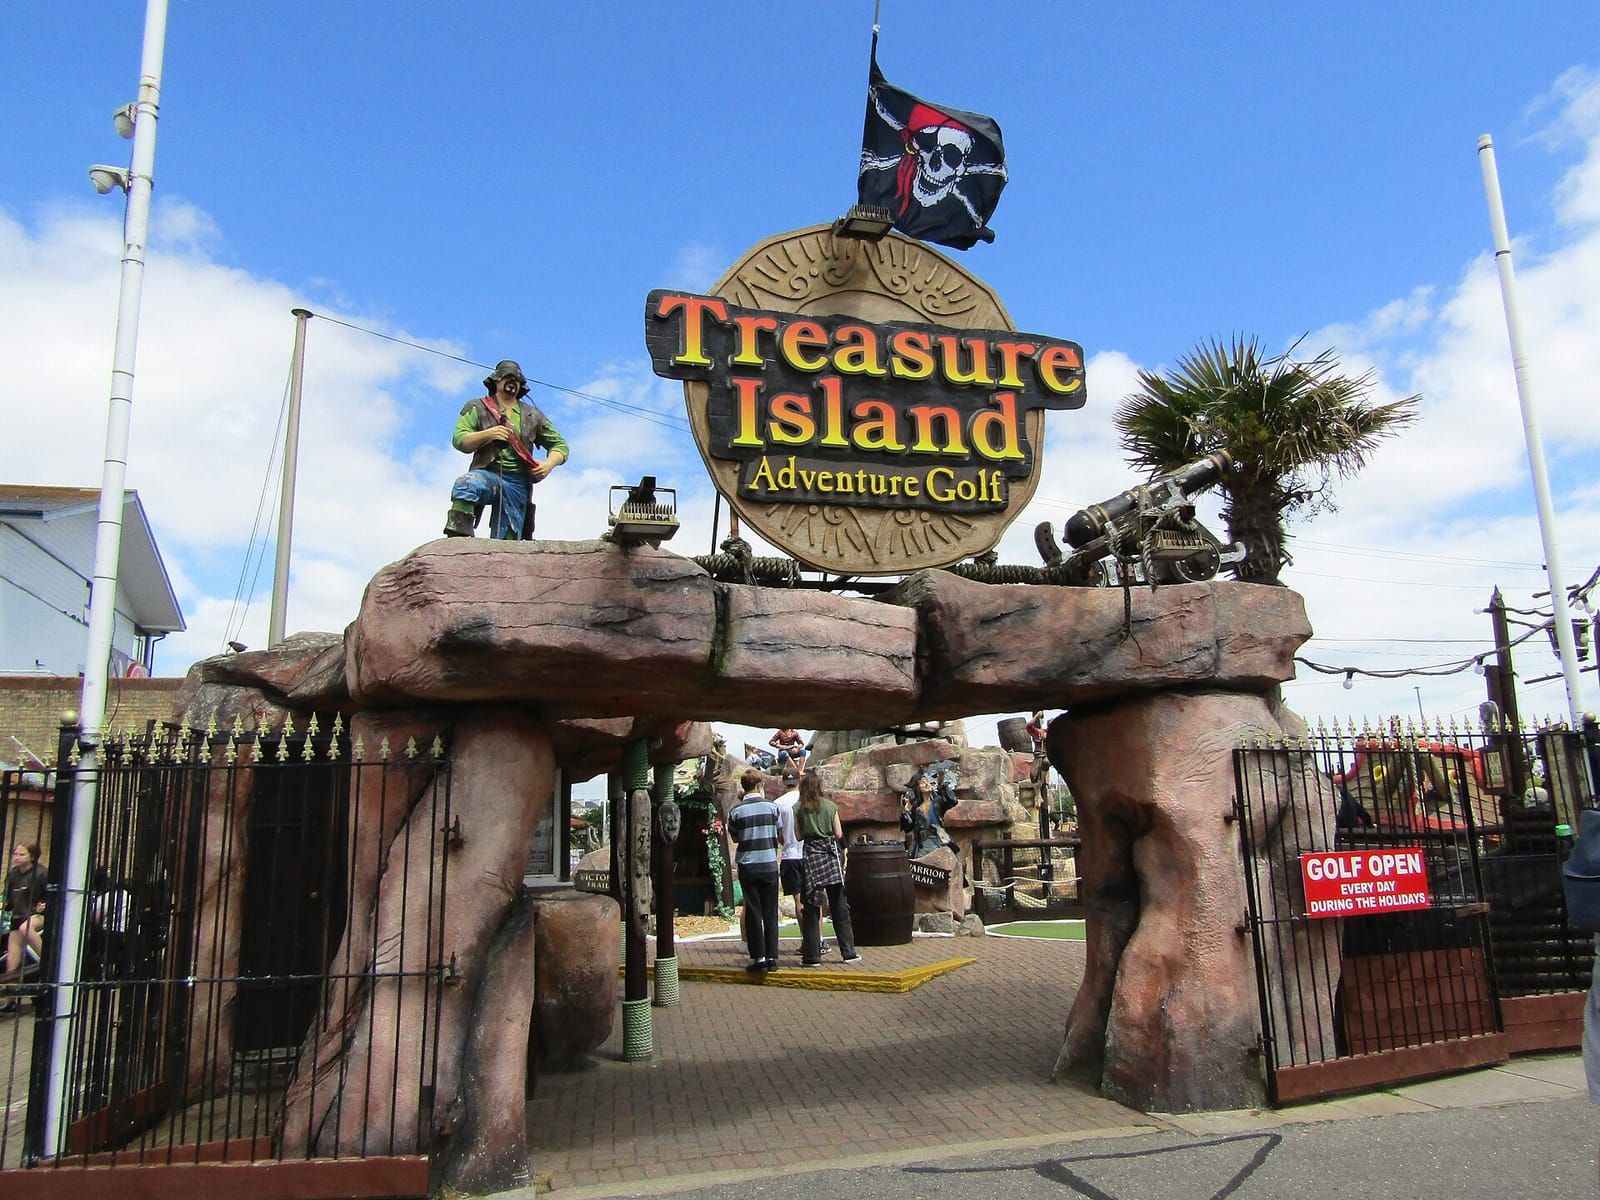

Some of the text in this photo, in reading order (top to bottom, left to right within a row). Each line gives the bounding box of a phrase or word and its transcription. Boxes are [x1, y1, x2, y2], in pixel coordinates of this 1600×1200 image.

[658, 295, 1082, 394] Treasure
[731, 376, 1026, 461] Island
[748, 455, 1004, 503] Adventure Golf
[911, 873, 935, 885] TRAIL
[1306, 853, 1422, 881] GOLF OPEN
[587, 881, 610, 889] TRAIL
[1340, 880, 1396, 895] EVERY DAY
[1310, 892, 1426, 913] DURING THE HOLIDAYS
